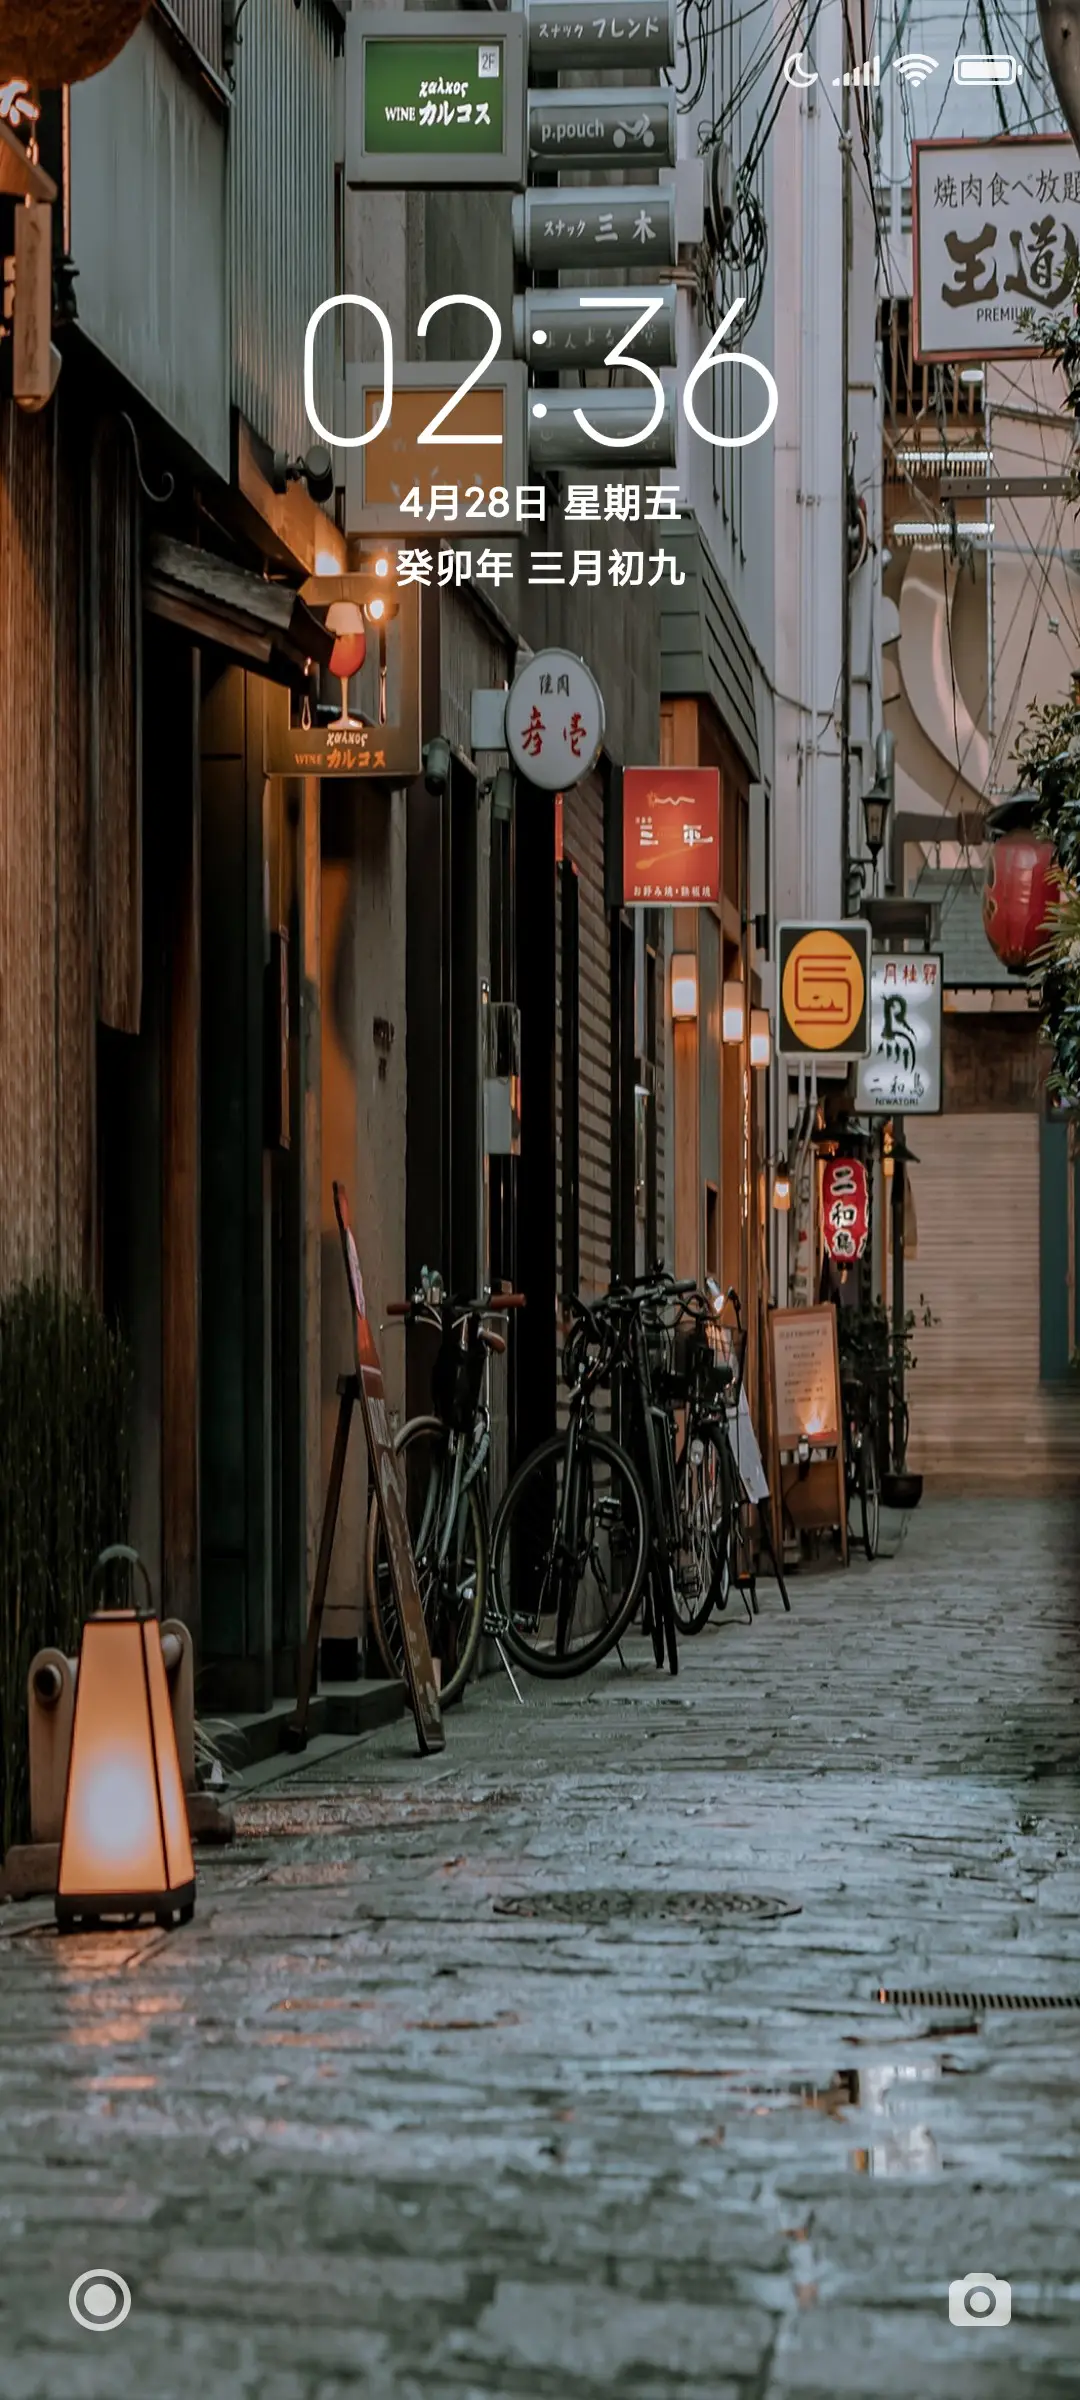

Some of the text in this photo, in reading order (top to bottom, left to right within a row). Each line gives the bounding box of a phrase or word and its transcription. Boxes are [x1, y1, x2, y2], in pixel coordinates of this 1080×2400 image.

[540, 16, 659, 39] スナック フレンド
[482, 52, 496, 70] 2F
[385, 99, 491, 126] WINE カルコス
[541, 118, 605, 143] p.pouch
[543, 219, 586, 237] スナック
[941, 213, 1079, 310] 王道
[294, 748, 386, 769] WINE カルコス
[875, 1097, 919, 1106] NIWATORI
